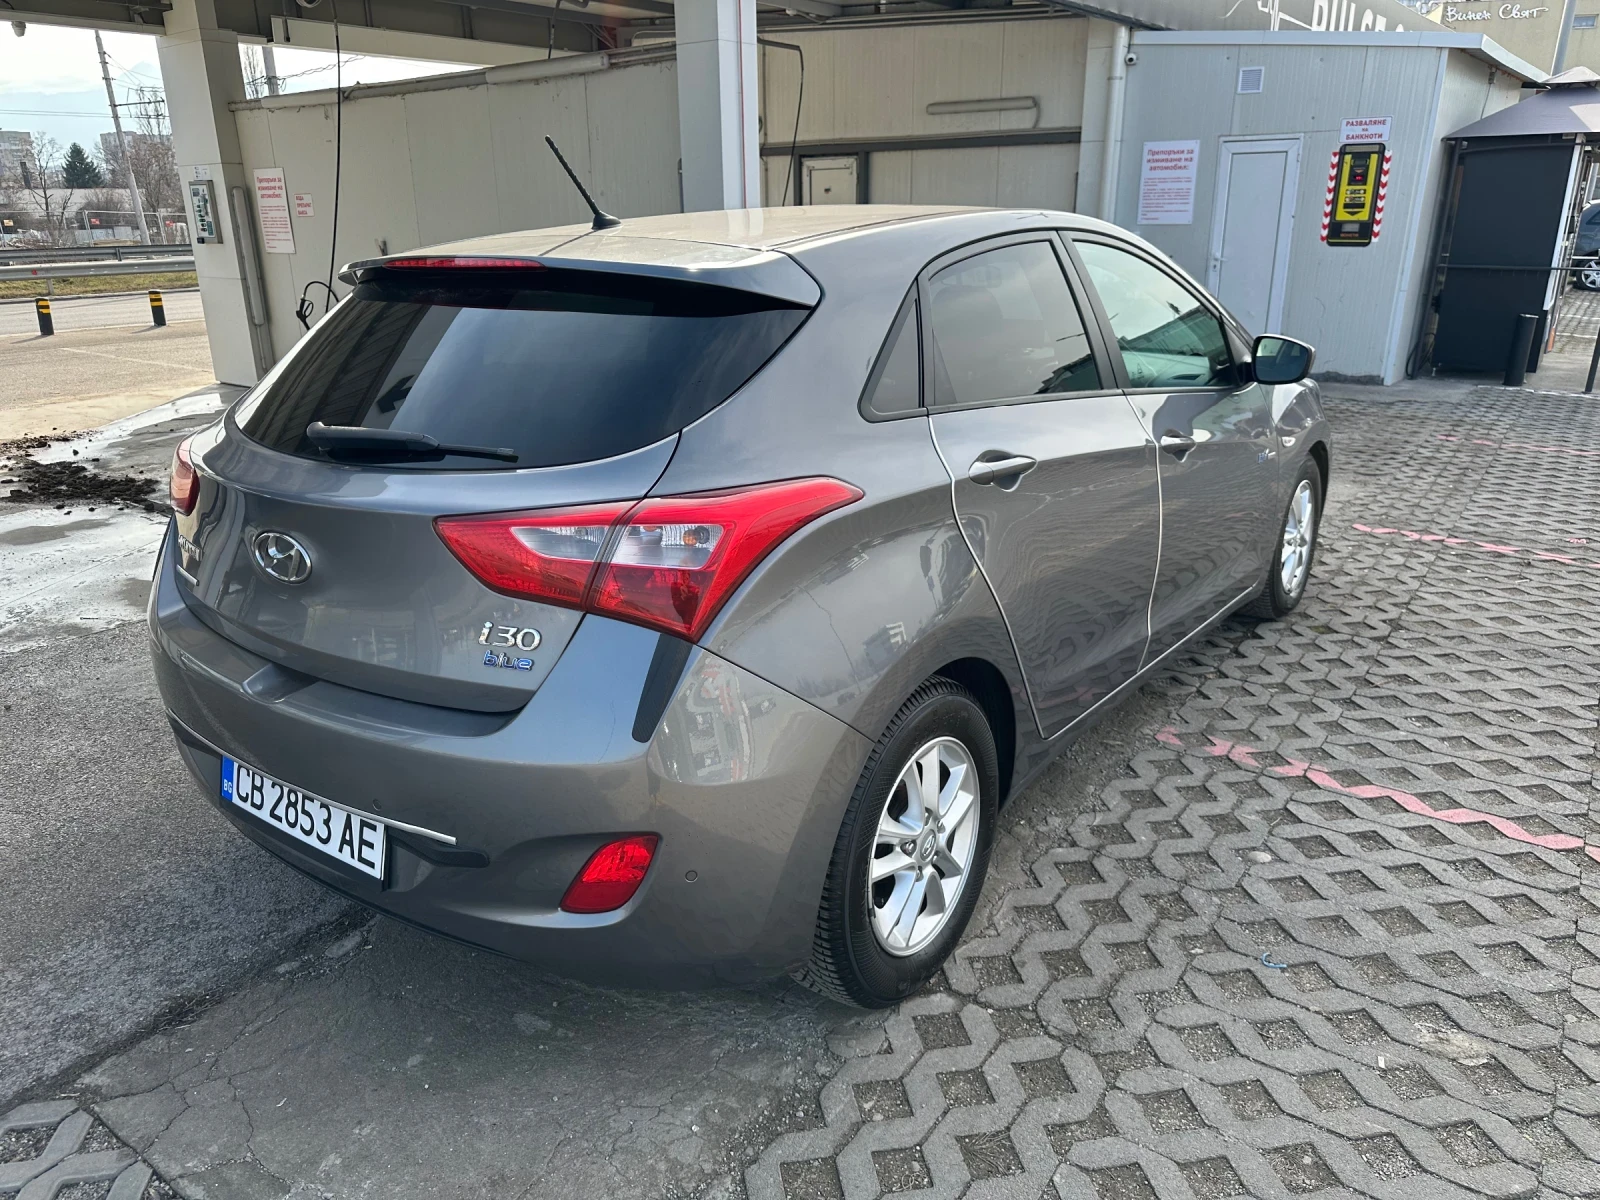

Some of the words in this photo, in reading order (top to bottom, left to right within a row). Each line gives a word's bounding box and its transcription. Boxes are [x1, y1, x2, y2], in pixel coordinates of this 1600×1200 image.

[1498, 3, 1549, 19] Свят
[1345, 119, 1387, 127] РАЗВАЛЯНЕ
[478, 621, 542, 651] i30
[482, 649, 534, 672] blue
[223, 778, 233, 794] BG
[236, 764, 265, 811] CB
[269, 781, 332, 845] 2853
[338, 812, 377, 870] AE
